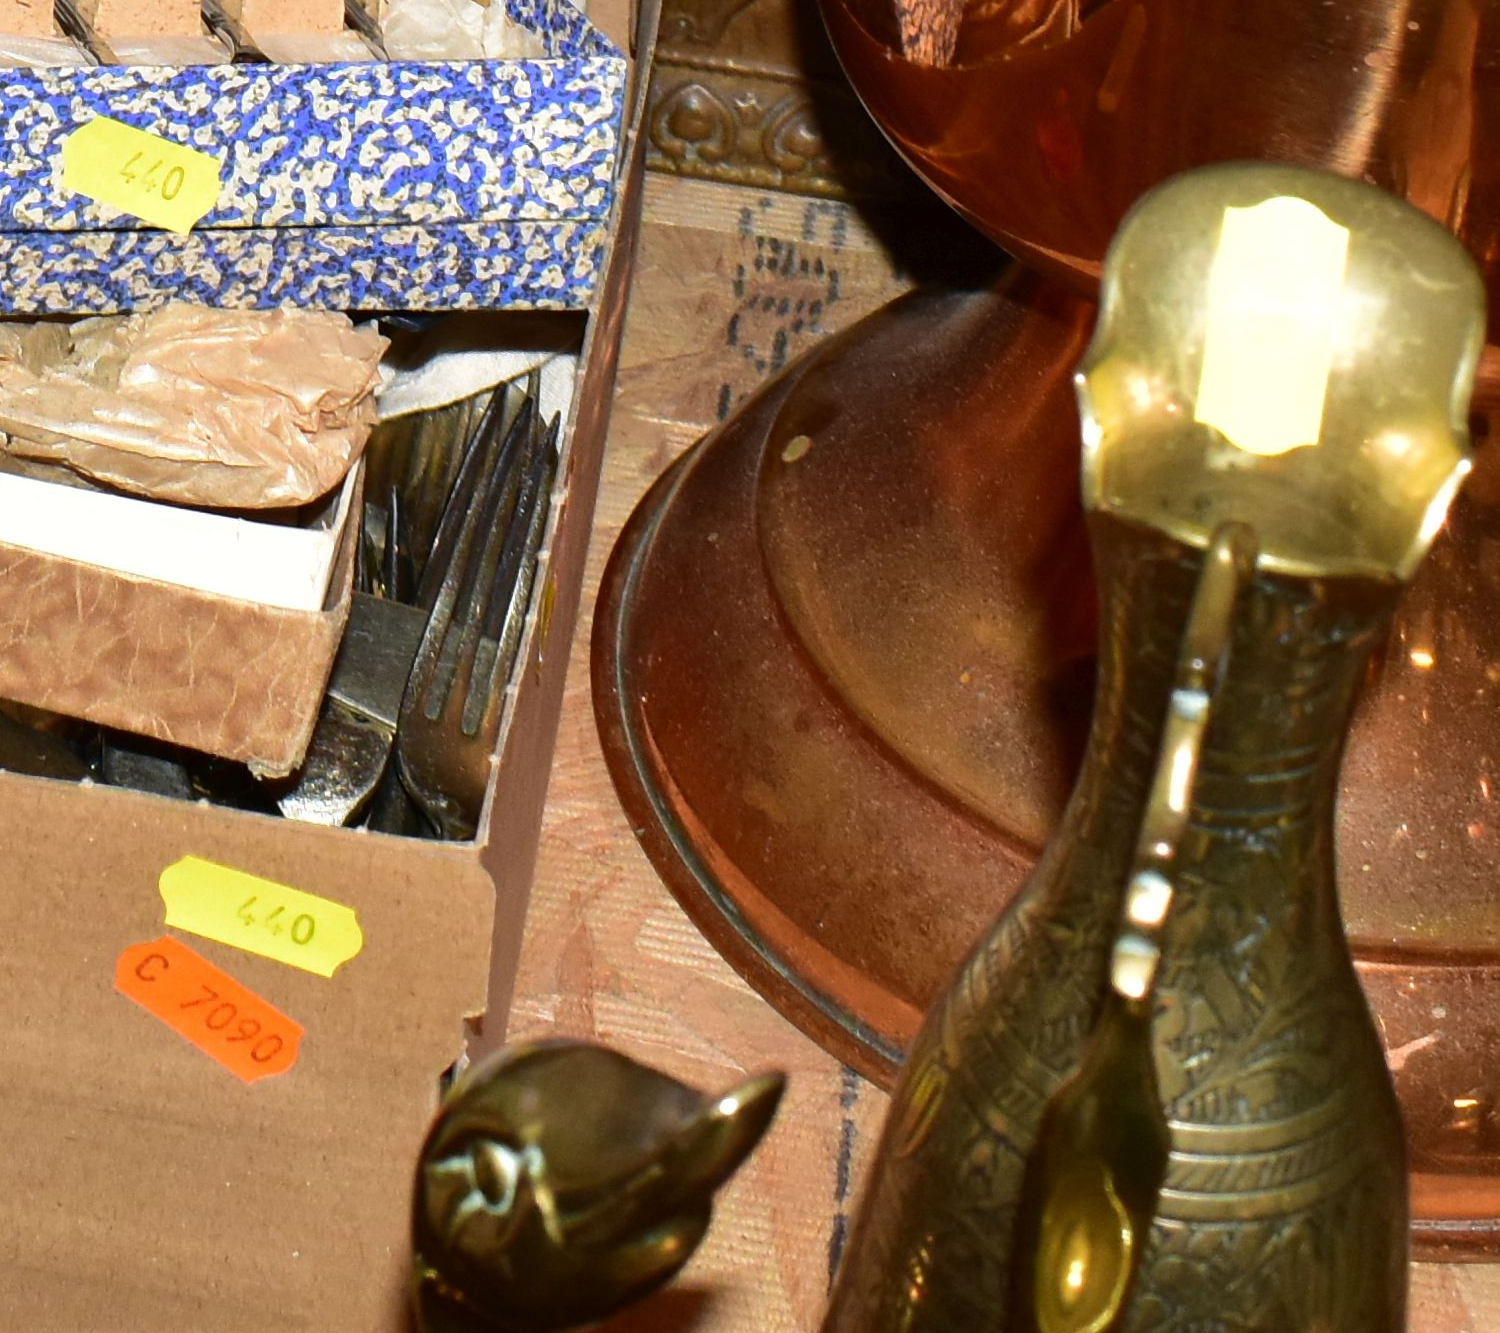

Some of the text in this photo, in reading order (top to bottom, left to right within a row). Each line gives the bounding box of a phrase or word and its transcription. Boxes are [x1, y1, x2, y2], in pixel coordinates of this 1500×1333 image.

[119, 151, 186, 201] 440
[235, 895, 316, 946] 440
[134, 952, 283, 1064] C 7090
